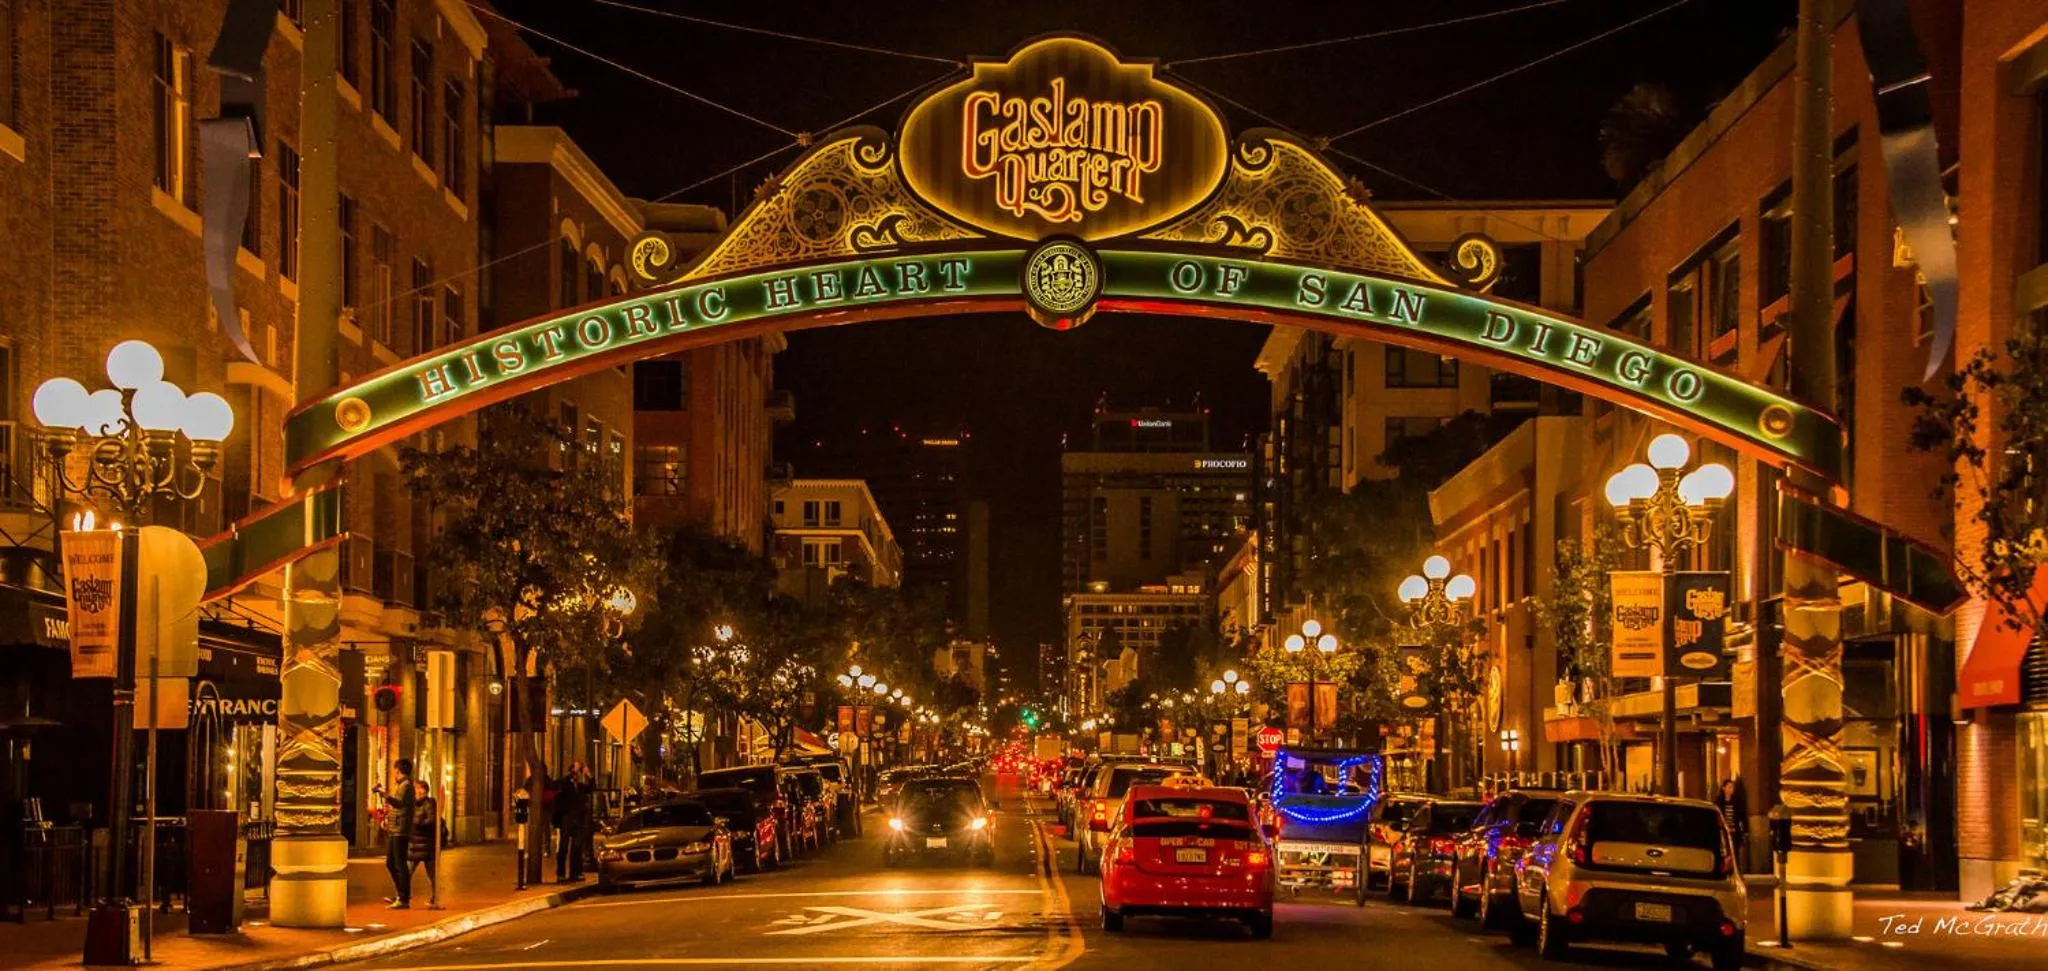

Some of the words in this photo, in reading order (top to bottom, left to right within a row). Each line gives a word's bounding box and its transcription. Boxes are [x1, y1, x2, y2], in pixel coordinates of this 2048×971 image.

[963, 77, 1163, 203] Gaslamp
[996, 148, 1144, 223] Quarter
[415, 286, 728, 402] HISTORIC
[762, 258, 970, 310] HEART
[1171, 259, 1248, 298] OF
[1297, 273, 1427, 325] SAN
[1480, 310, 1703, 403] DIEGO
[1259, 734, 1281, 745] STOP
[1173, 778, 1204, 786] TAXI
